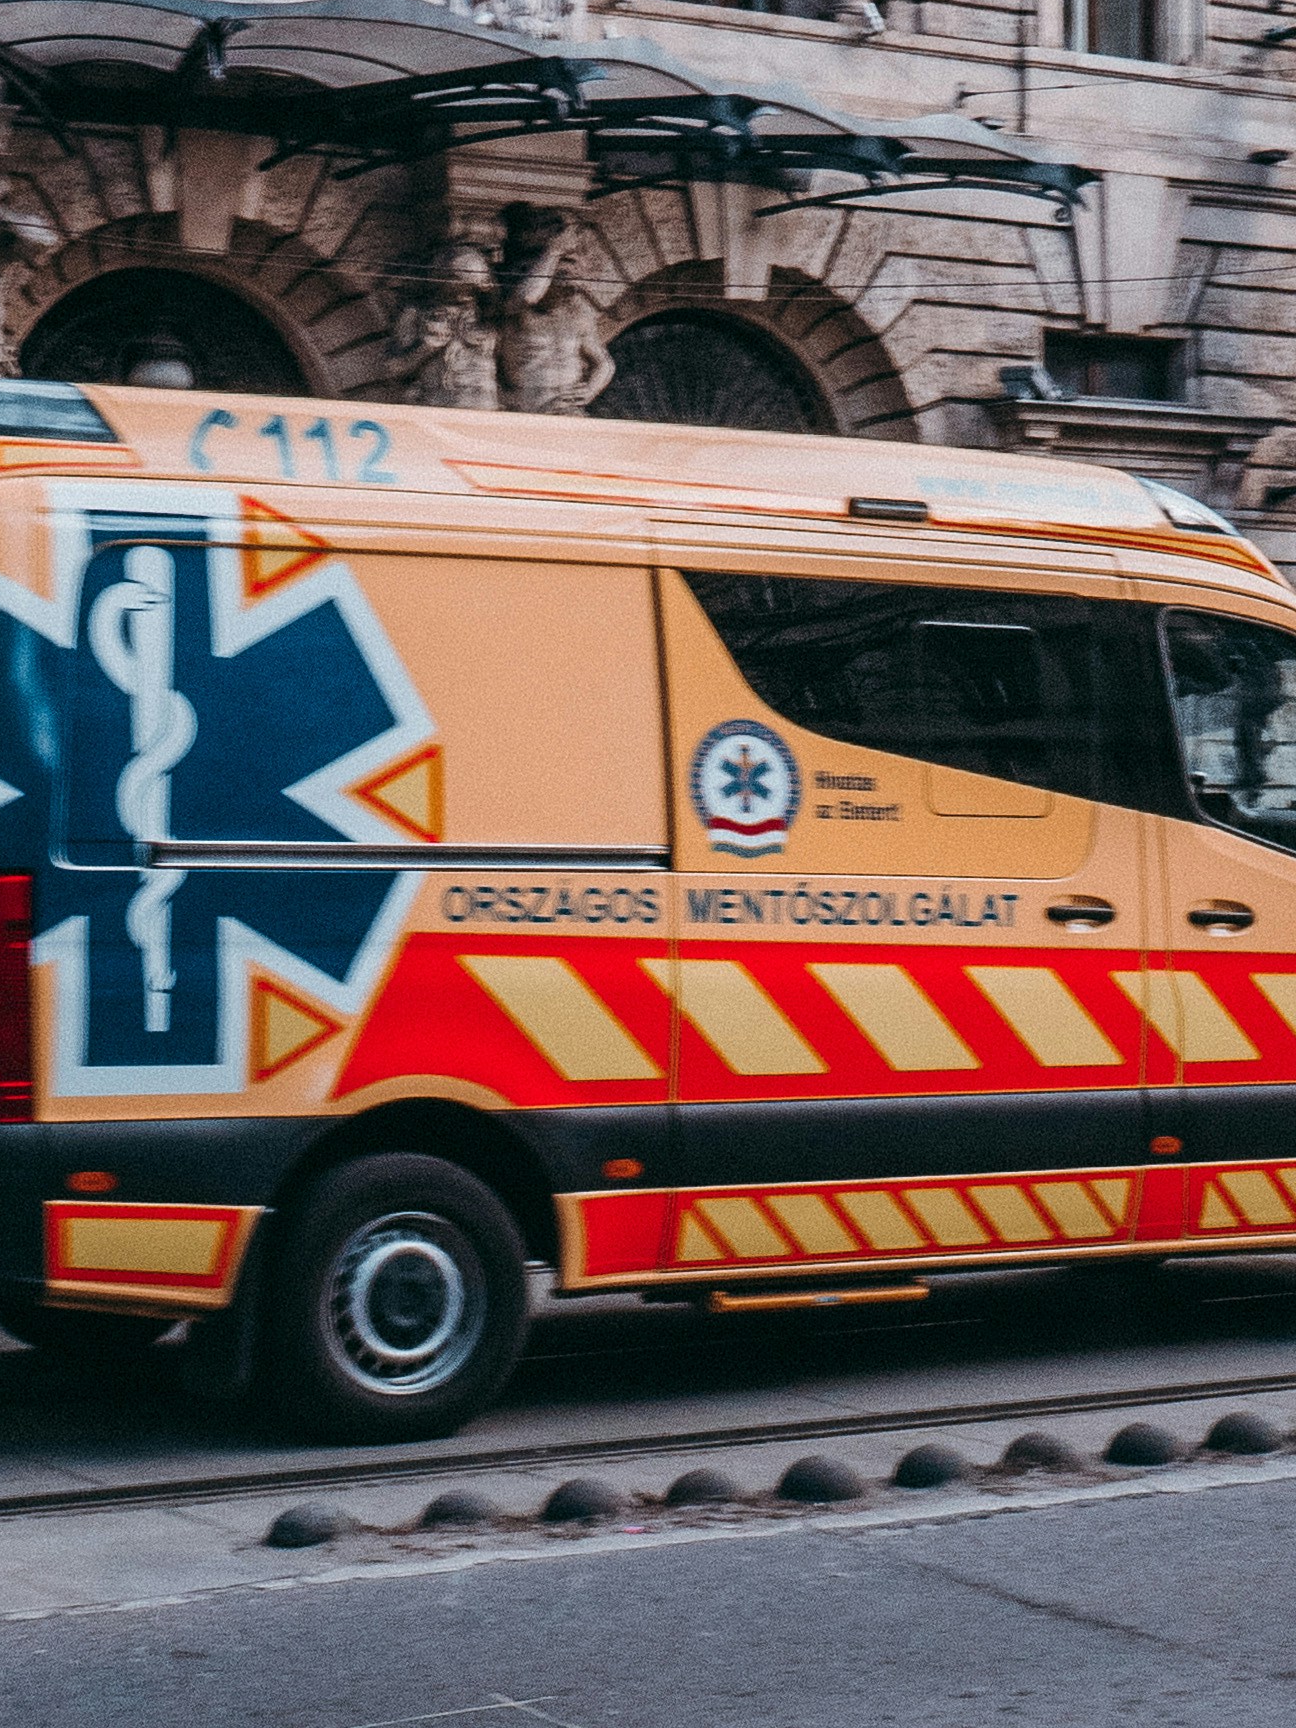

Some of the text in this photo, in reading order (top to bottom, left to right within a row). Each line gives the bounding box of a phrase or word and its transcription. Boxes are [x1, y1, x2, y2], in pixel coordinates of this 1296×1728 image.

[257, 414, 400, 484] 112
[441, 879, 1020, 928] ORSZÁGOS MENTŐSZOLGÁLAT
